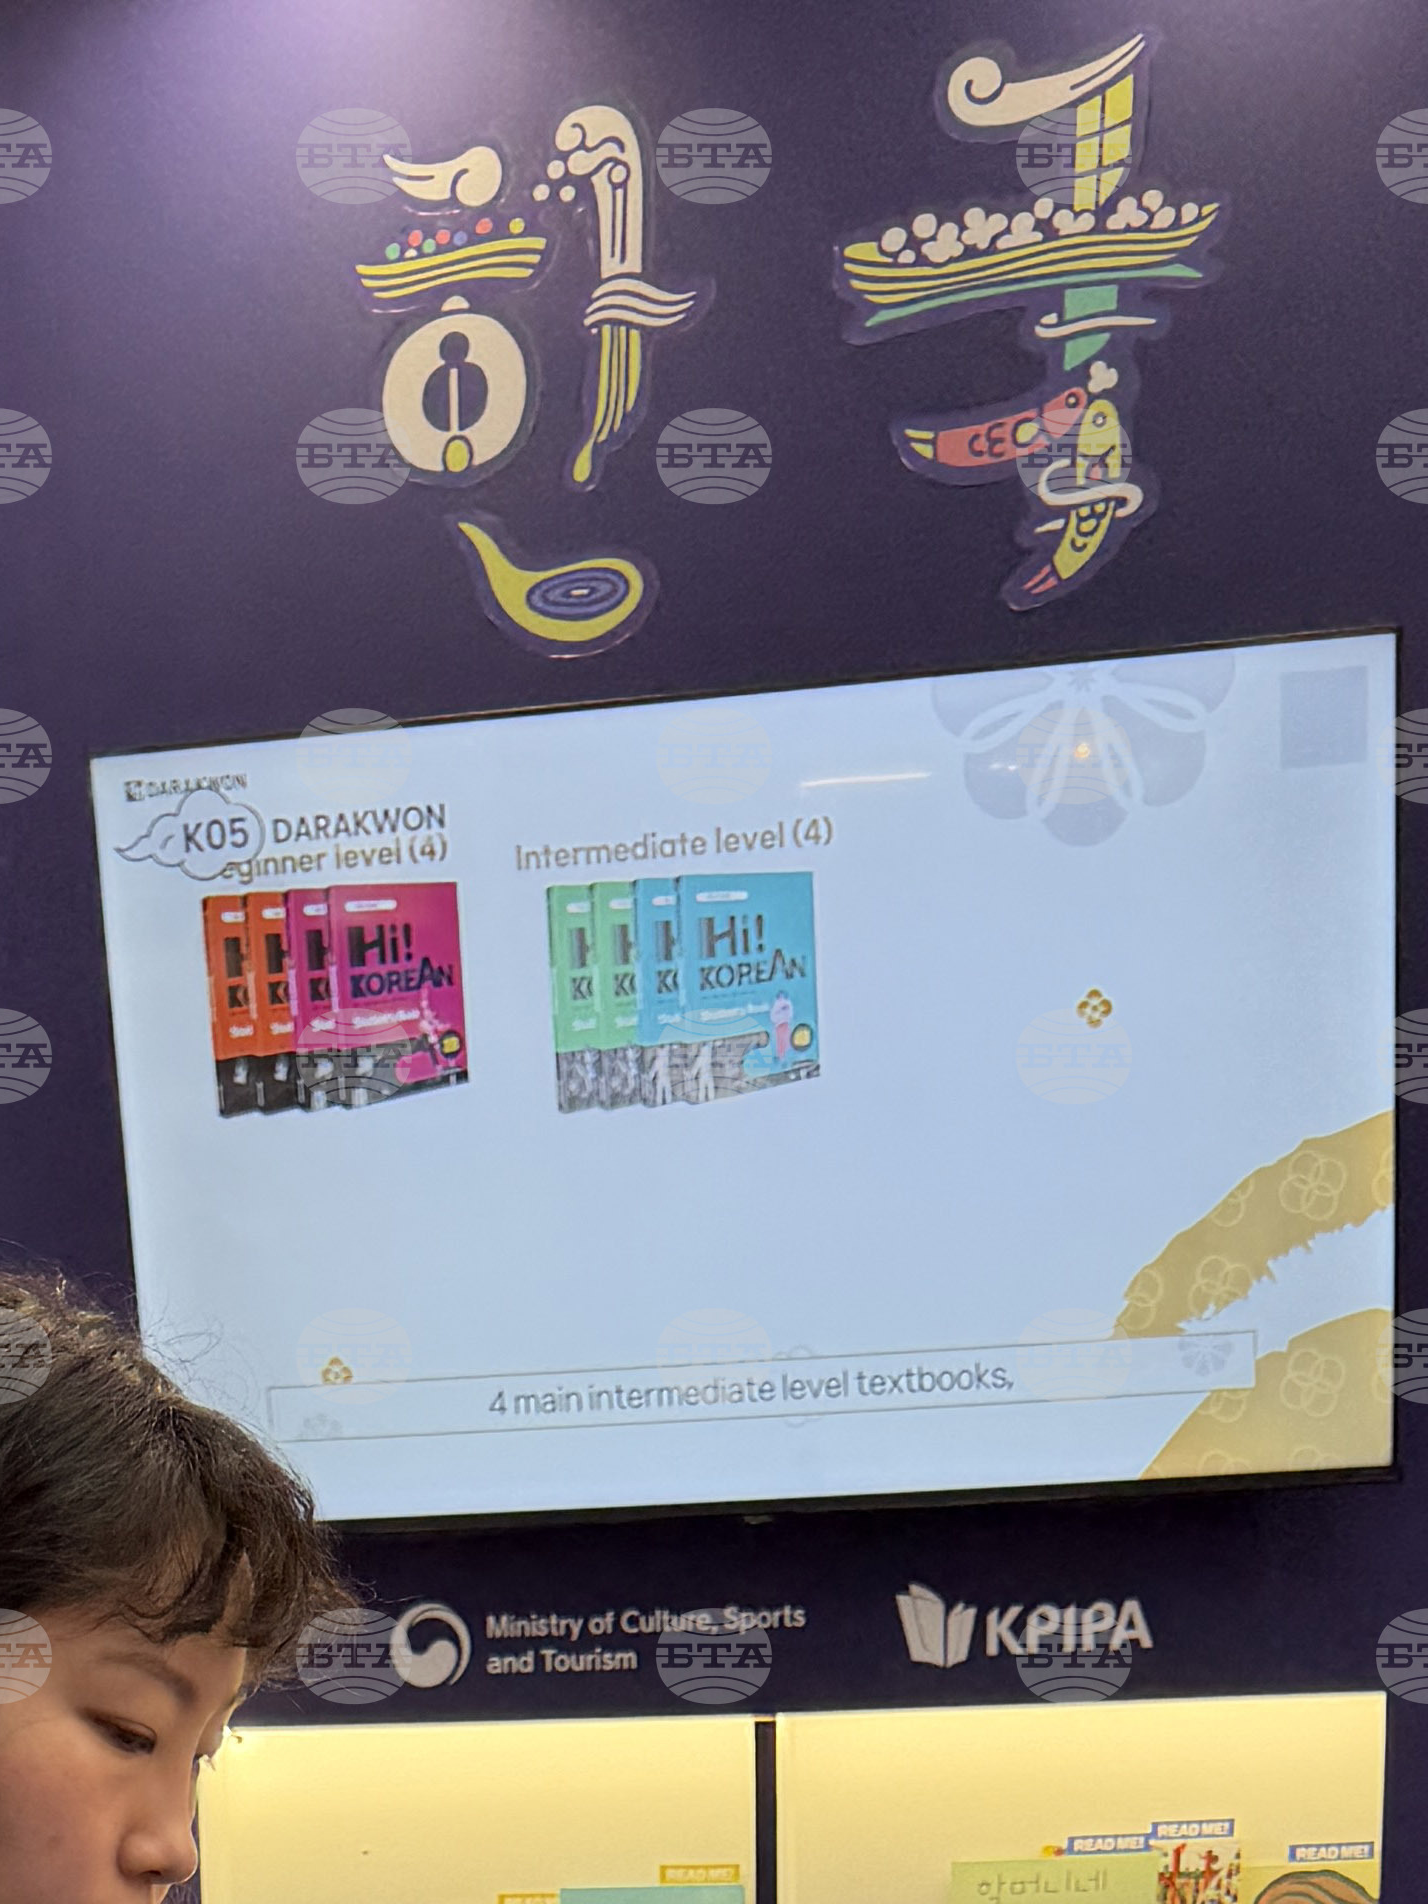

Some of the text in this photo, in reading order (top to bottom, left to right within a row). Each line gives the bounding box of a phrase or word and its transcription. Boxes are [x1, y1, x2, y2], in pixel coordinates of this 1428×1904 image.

[182, 817, 250, 853] K05
[272, 803, 447, 845] DARAKWON
[516, 815, 835, 870] Intermediate level (4)
[335, 841, 403, 871] level
[409, 836, 449, 864] (4)
[348, 923, 413, 967] Hi!
[699, 914, 766, 958] Hi!
[350, 957, 454, 999] KOREAN
[699, 948, 807, 991] KOREAN
[489, 1391, 507, 1416] 4
[514, 1386, 582, 1416] main
[588, 1374, 775, 1412] intermediate
[782, 1370, 849, 1403] level
[486, 1603, 806, 1641] Ministry of Culture, Sports
[985, 1599, 1155, 1658] KPIPA
[486, 1648, 638, 1675] and Tourism
[1073, 1838, 1114, 1852] READ
[1157, 1821, 1230, 1838] READ ME!
[1296, 1846, 1339, 1861] READ
